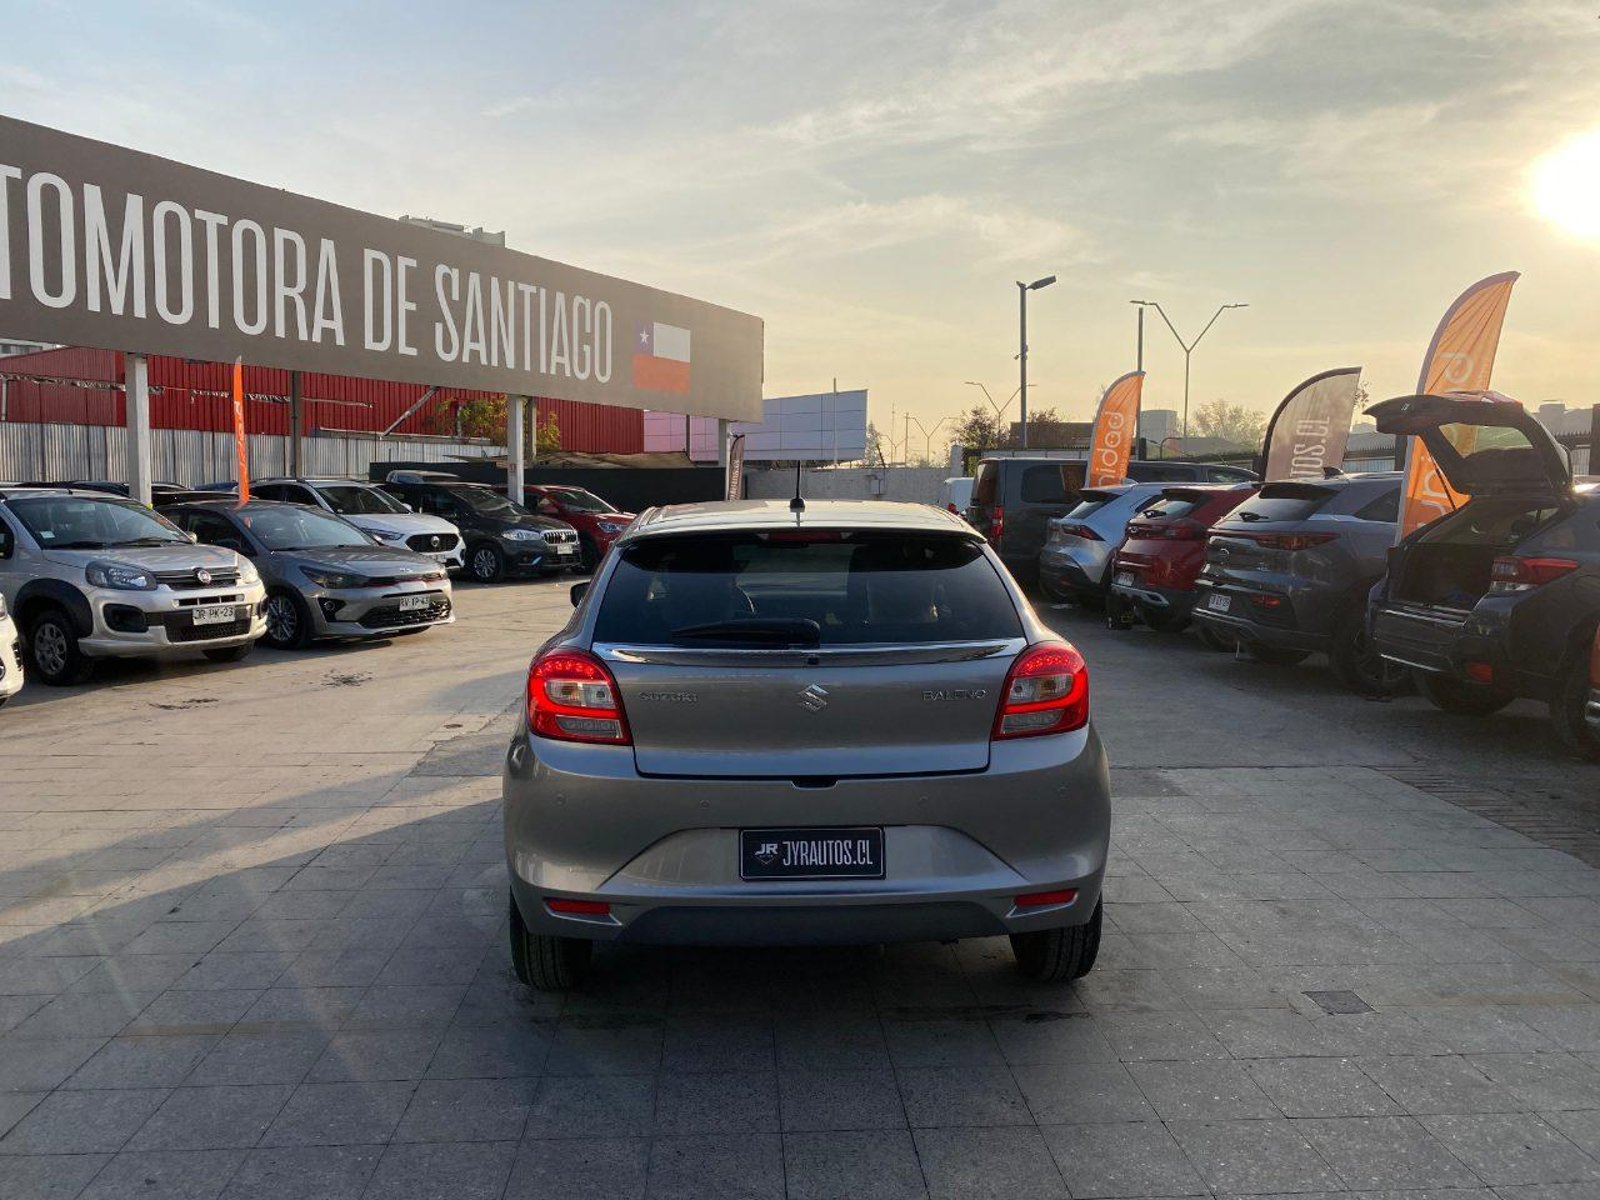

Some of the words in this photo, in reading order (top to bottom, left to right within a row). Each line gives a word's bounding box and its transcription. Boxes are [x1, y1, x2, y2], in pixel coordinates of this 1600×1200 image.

[363, 248, 418, 356] DE
[434, 263, 612, 383] SANTIAGO
[754, 843, 778, 856] JR
[782, 840, 873, 866] JYRAUTOS.CL
